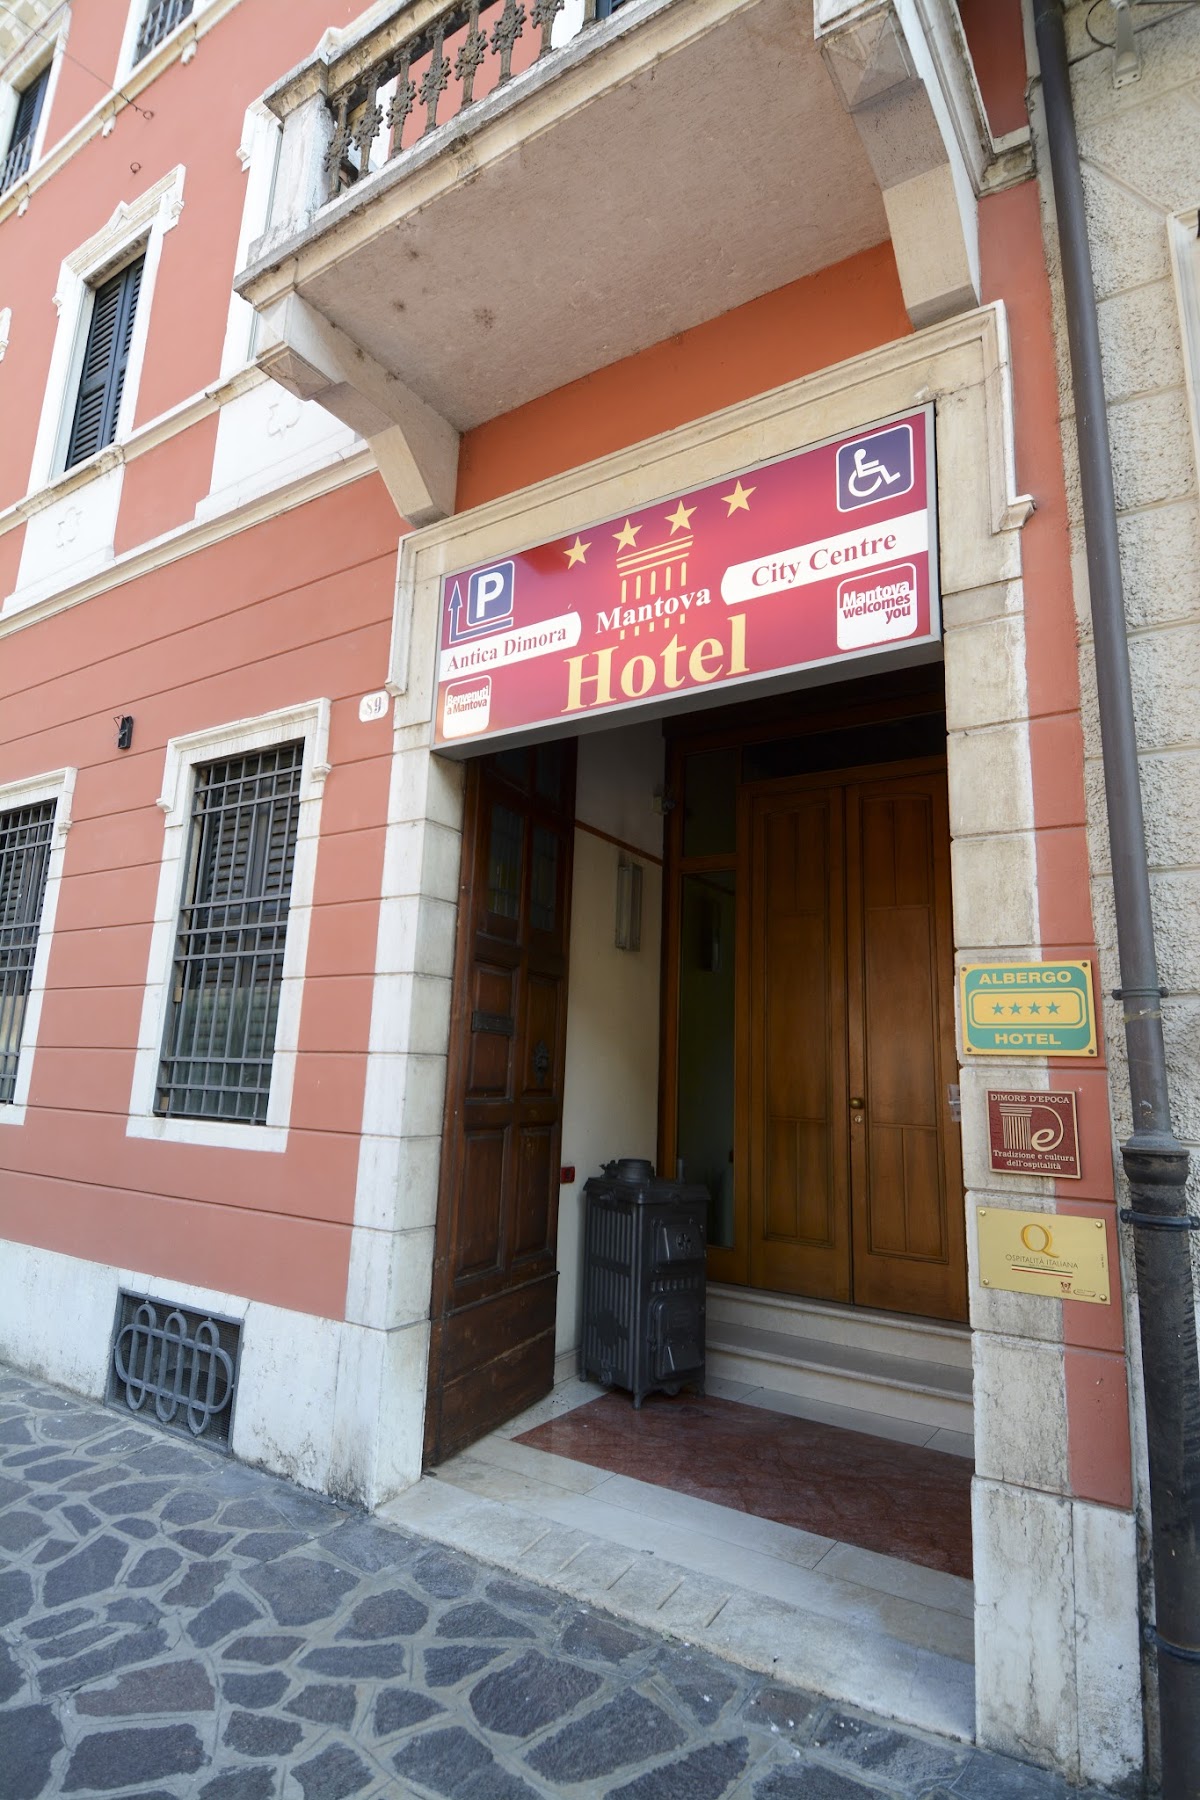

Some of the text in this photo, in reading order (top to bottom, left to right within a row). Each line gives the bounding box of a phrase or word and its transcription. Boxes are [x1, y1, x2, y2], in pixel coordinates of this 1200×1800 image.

[751, 534, 897, 587] City Centre
[476, 571, 505, 619] P
[842, 581, 910, 609] Mantova
[595, 587, 712, 634] Mantova
[842, 593, 911, 619] welcomes
[885, 604, 911, 625] you
[446, 627, 567, 672] Antica Dimora
[560, 613, 750, 713] Hotel
[447, 685, 489, 706] Benvenuti
[446, 698, 488, 716] a Mantova
[979, 970, 1072, 985] ALBERGO
[994, 1033, 1062, 1045] HOTEL
[990, 1094, 1070, 1104] DIMORE D'EPOCA
[993, 1149, 1036, 1160] Tradizione
[1044, 1153, 1075, 1162] cultura
[1006, 1160, 1062, 1170] dell'ospitalità
[1020, 1223, 1060, 1259] Q
[1005, 1254, 1045, 1266] OSPITALITÀ
[1046, 1258, 1079, 1270] ITALIANA
